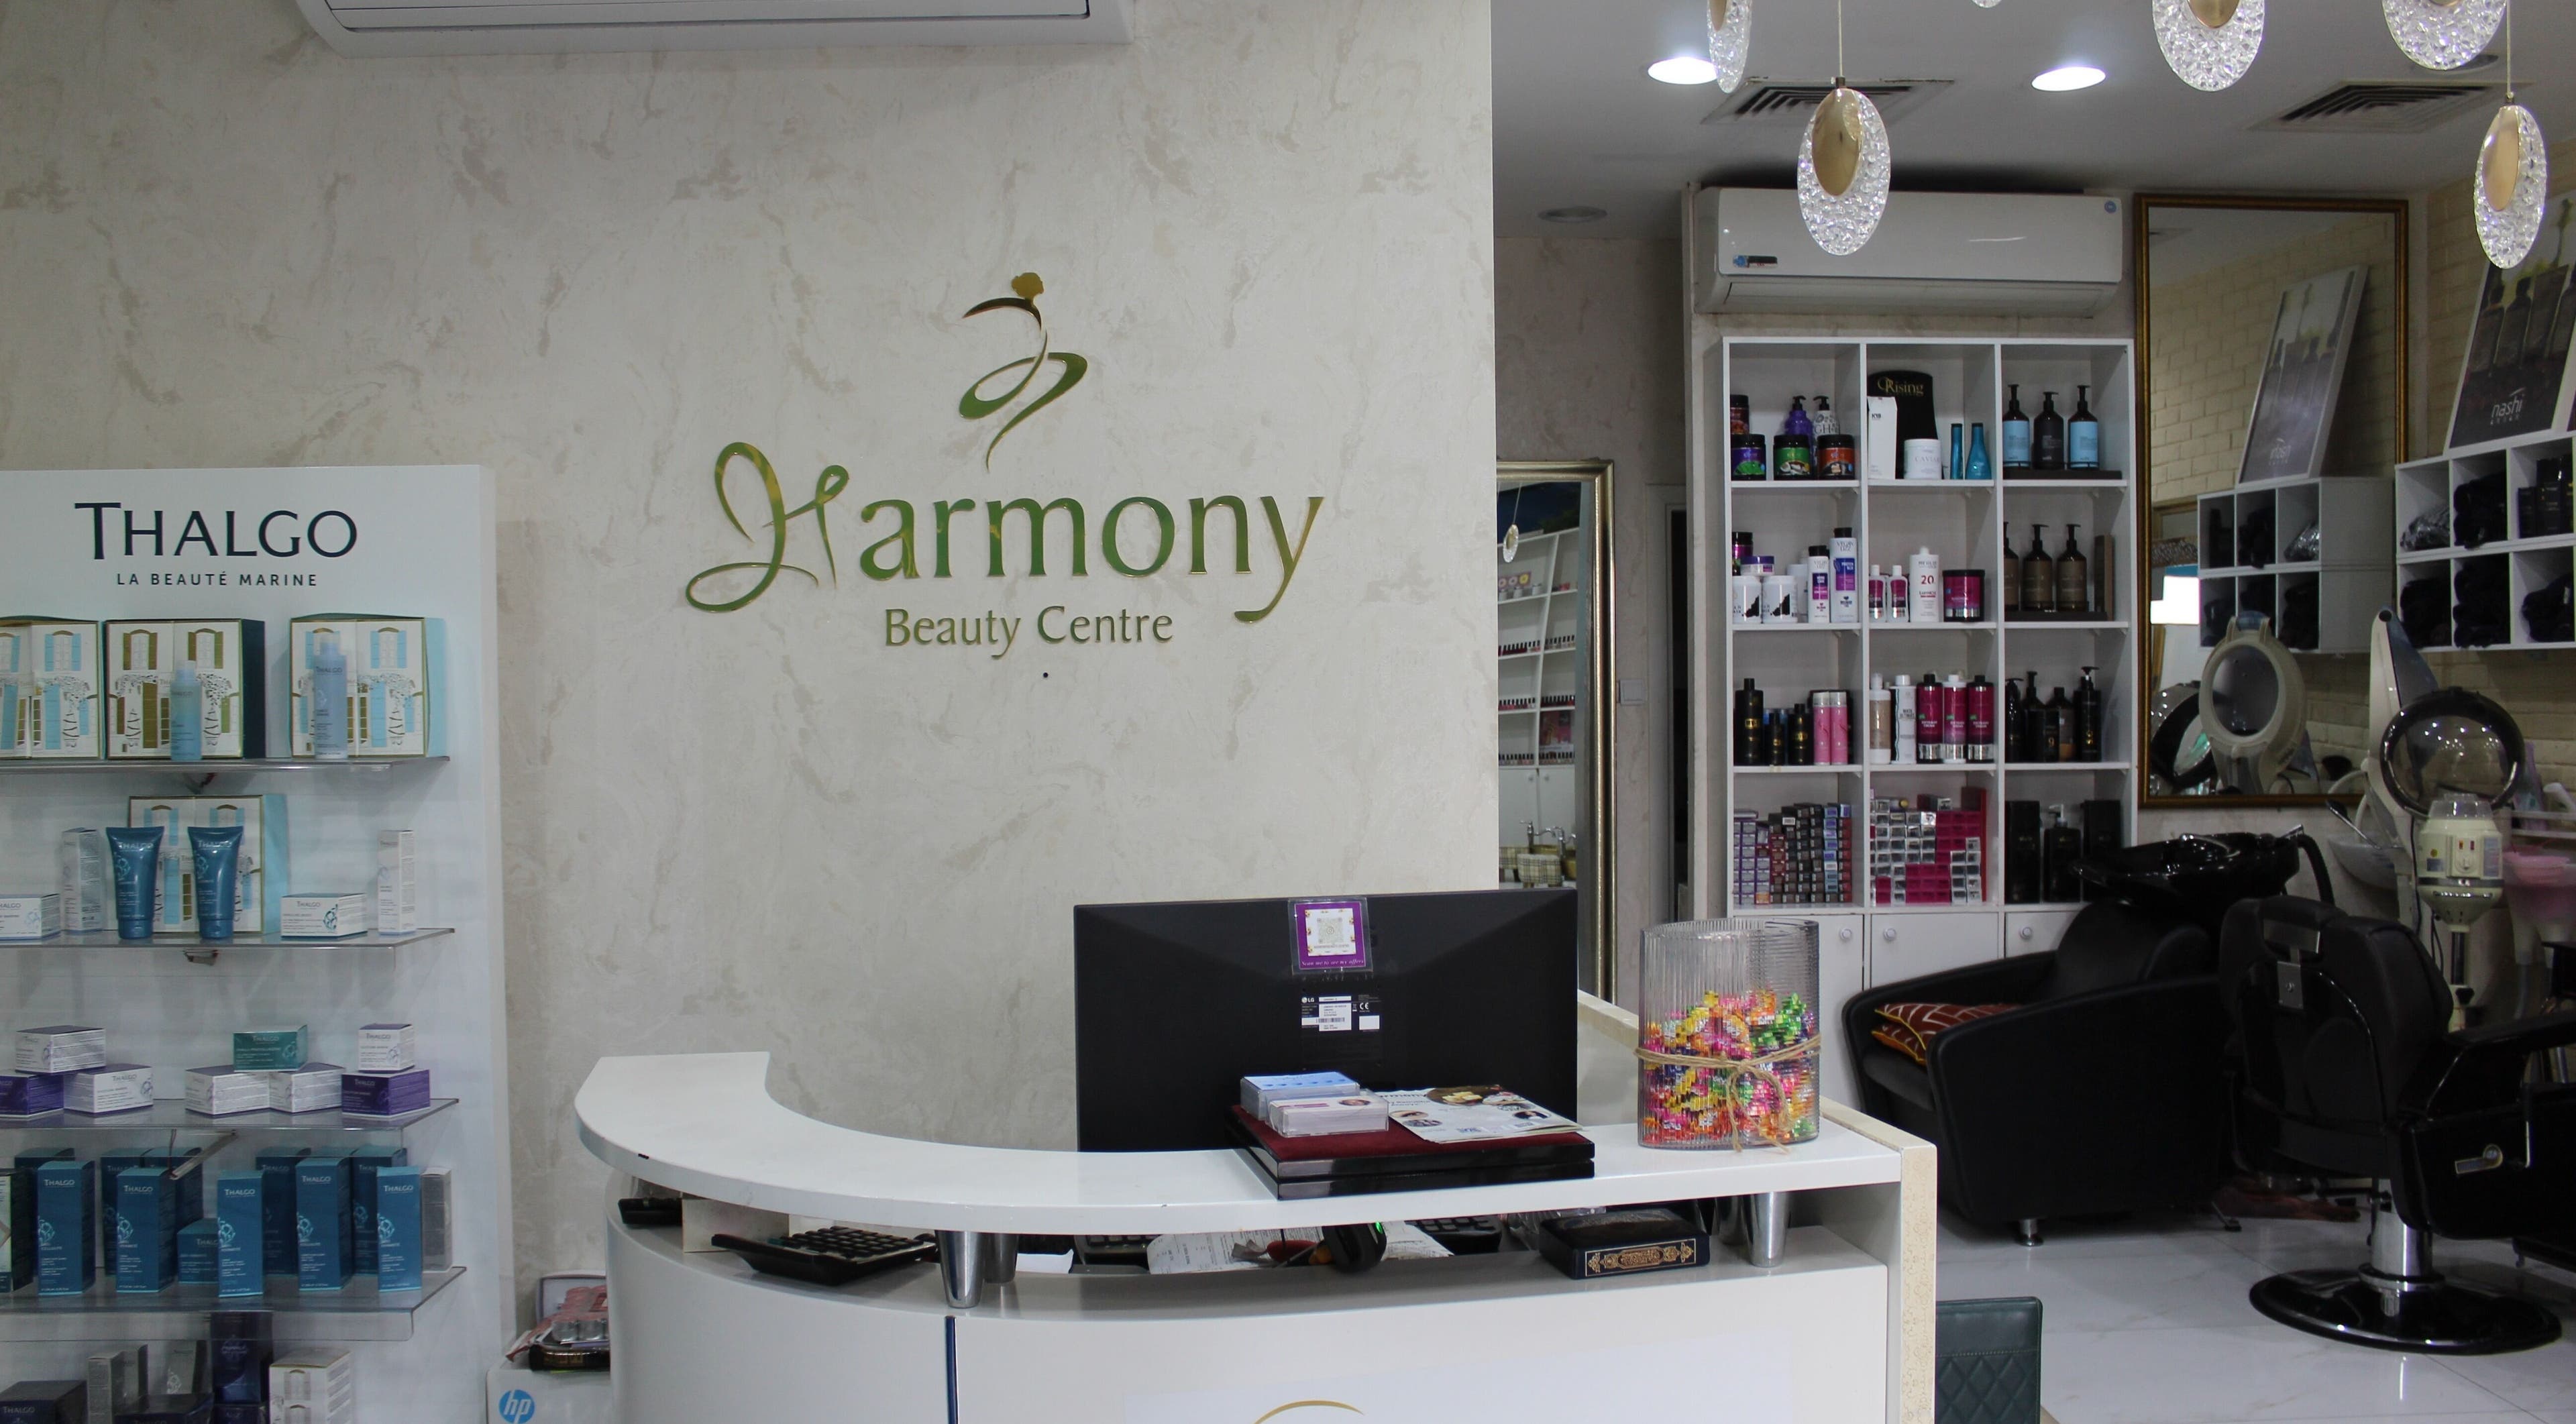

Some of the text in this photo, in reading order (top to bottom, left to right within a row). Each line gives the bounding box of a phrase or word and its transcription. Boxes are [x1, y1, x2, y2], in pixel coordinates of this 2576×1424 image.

[2491, 392, 2524, 418] nashi
[74, 502, 358, 561] THALGO
[685, 441, 1324, 624] Harmony
[117, 570, 318, 587] LA BEAUTÉ MARINE
[1921, 575, 1934, 585] 20
[885, 605, 1173, 659] Beauty Centre
[302, 1175, 331, 1183] THALGO
[123, 1185, 154, 1193] THALGO
[223, 1189, 256, 1197] THALGO
[382, 1185, 414, 1193] THALGO
[503, 1390, 531, 1424] hp
